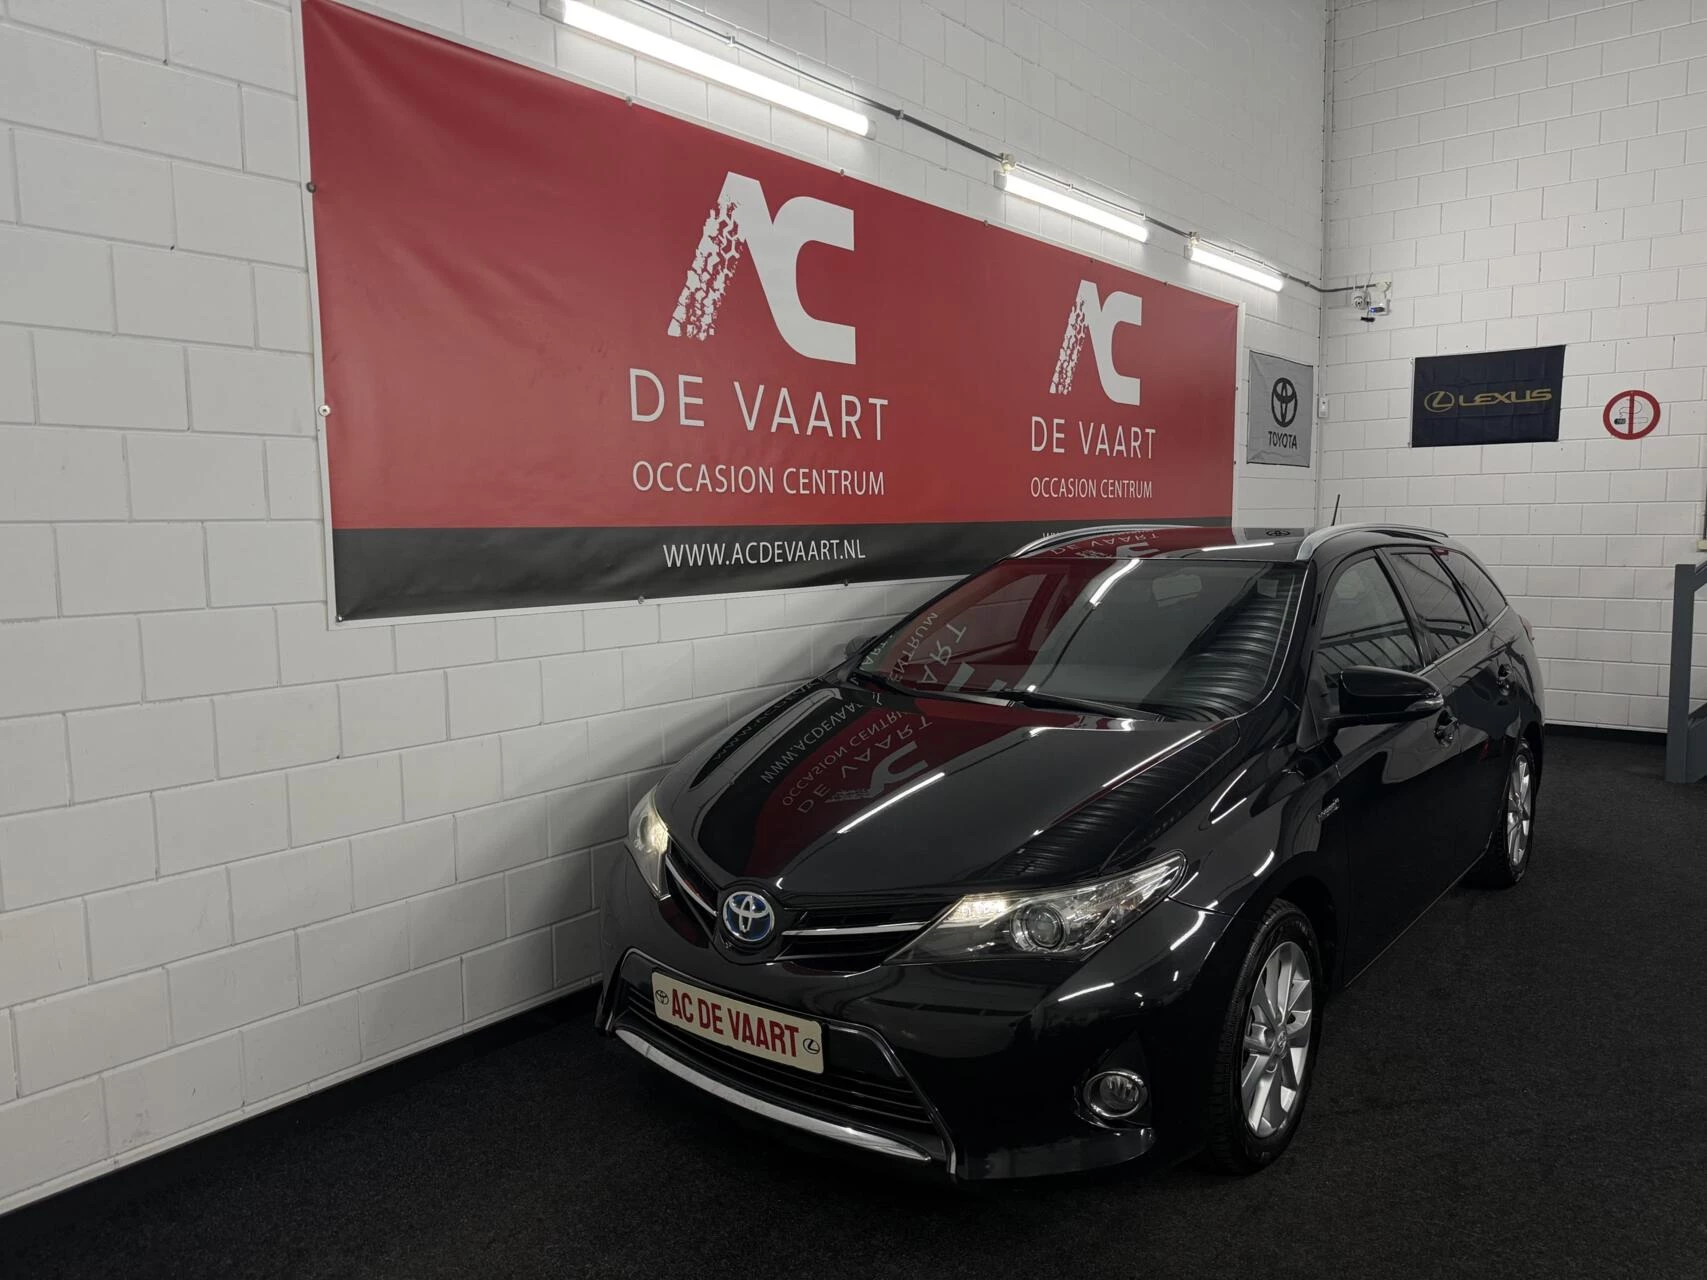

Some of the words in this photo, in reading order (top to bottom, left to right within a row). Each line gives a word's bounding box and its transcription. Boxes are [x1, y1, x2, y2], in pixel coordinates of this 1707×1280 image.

[629, 367, 705, 427] DE
[733, 380, 889, 441] VAART
[1458, 388, 1553, 407] LEXUS
[1031, 415, 1066, 453] DE
[1078, 420, 1157, 460] VAART
[1268, 430, 1298, 450] TOYOTA
[632, 460, 775, 494] OCCASION
[782, 467, 886, 496] CENTRUM
[1030, 476, 1097, 498] OCCASION
[1100, 479, 1153, 499] CENTRUM
[663, 539, 867, 568] WWW.ACDEVAART.NL
[671, 987, 695, 1023] AC
[697, 997, 725, 1036] DE
[727, 1007, 800, 1058] VAART
